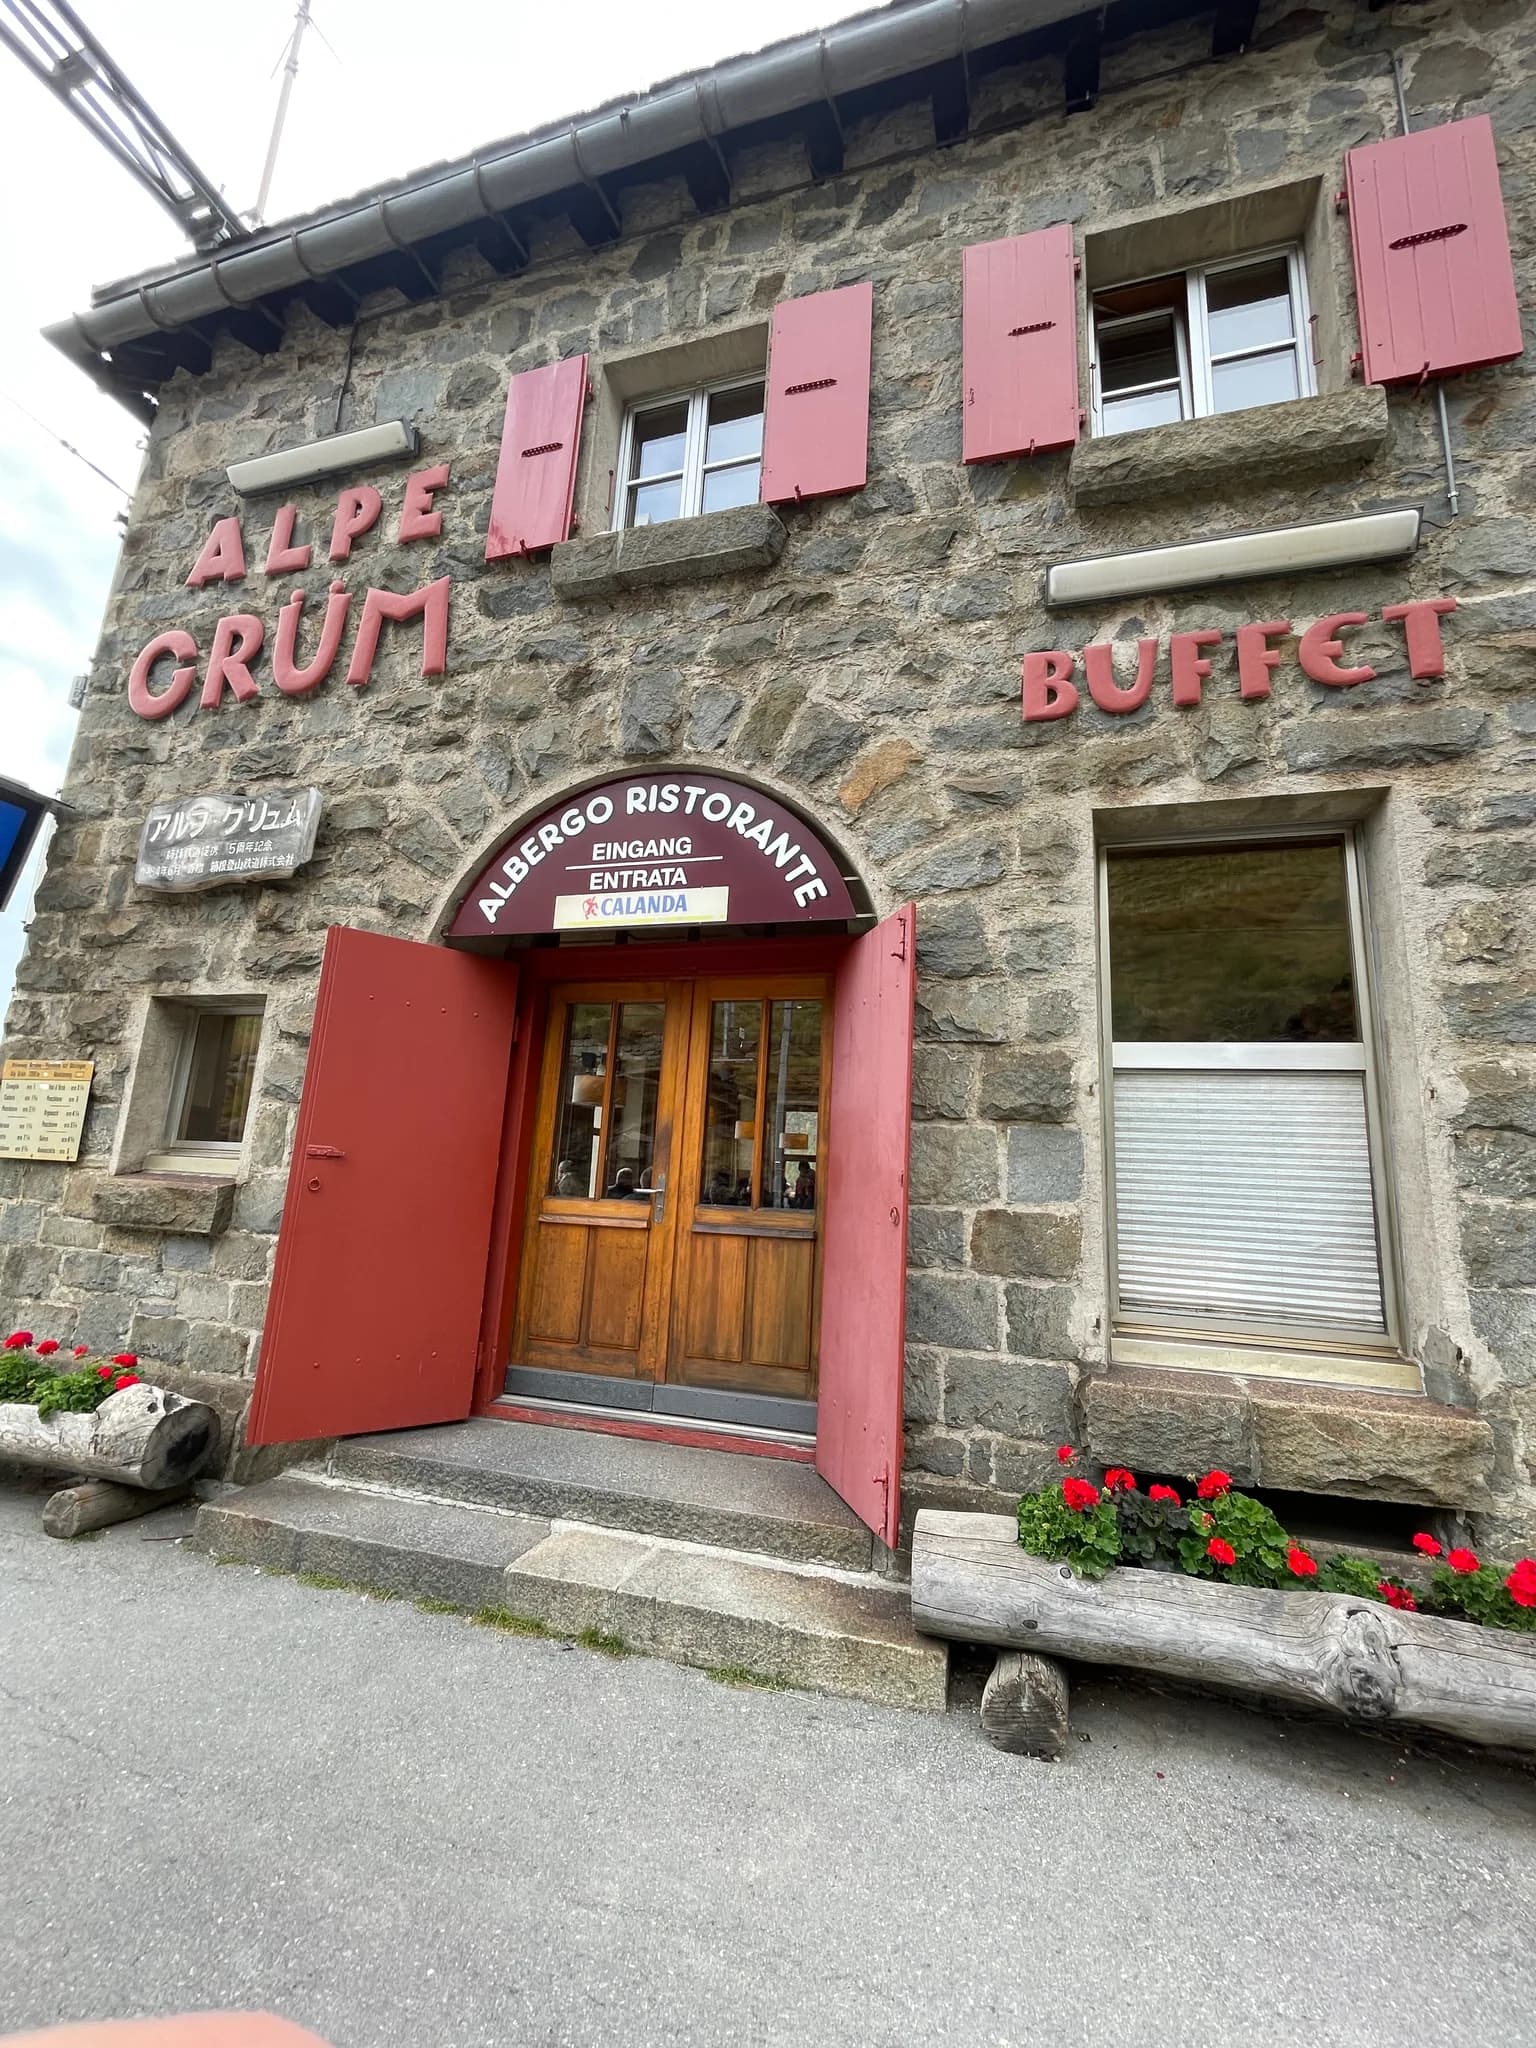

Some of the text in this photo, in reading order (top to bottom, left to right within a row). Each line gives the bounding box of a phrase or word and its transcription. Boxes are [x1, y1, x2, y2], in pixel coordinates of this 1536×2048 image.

[185, 464, 450, 588] ALPE
[1022, 598, 1457, 722] BUFFET
[478, 784, 828, 924] ALBERGO RISTORANTE
[589, 866, 687, 890] ENTRATA
[592, 836, 692, 861] EINGANG
[600, 894, 688, 916] CALANDA
